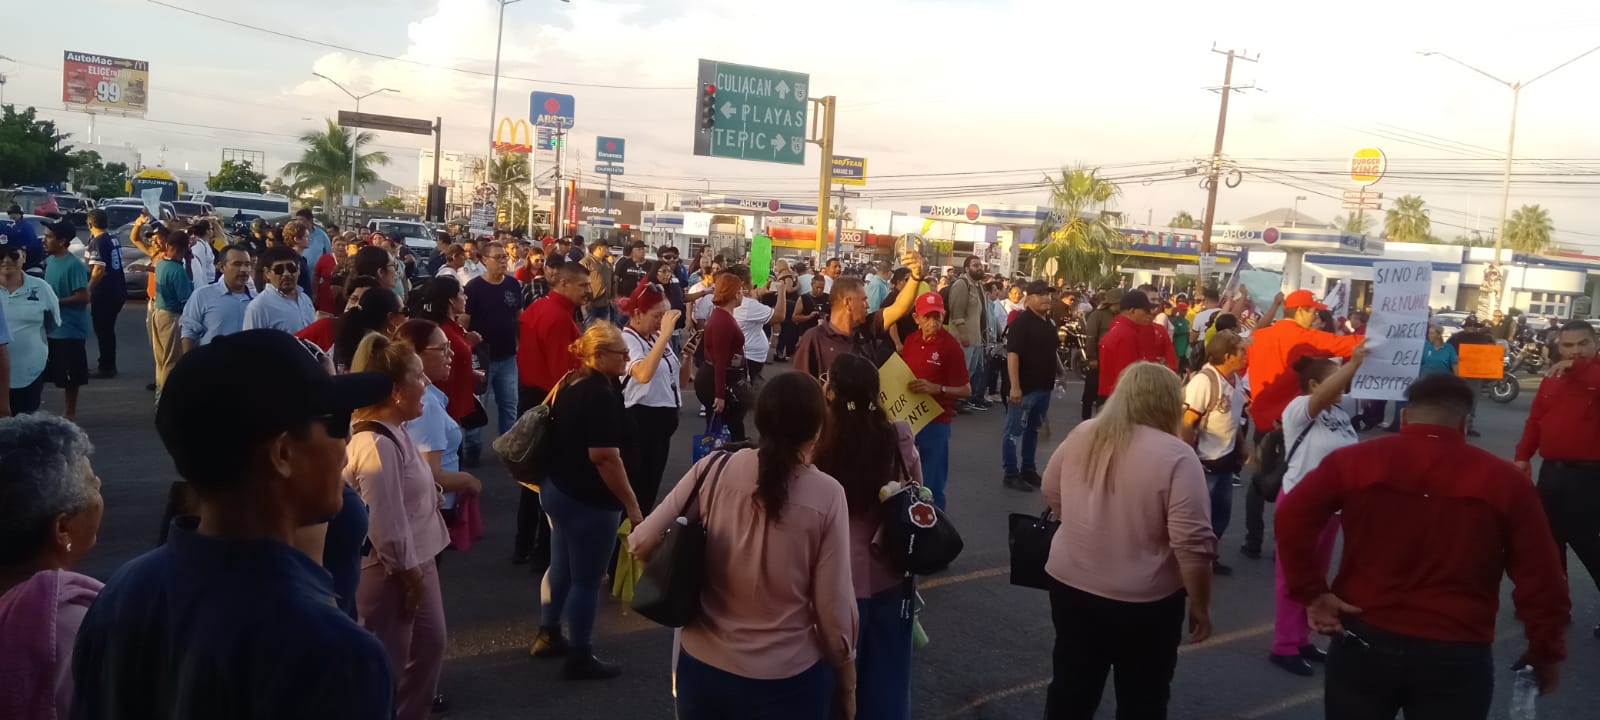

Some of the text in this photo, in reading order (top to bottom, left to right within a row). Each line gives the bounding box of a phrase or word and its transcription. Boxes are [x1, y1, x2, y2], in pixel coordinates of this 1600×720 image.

[67, 52, 113, 66] AutoMac
[88, 65, 111, 76] ELIGE
[717, 73, 772, 97] CULIACAN
[741, 103, 804, 128] PLAYAS
[715, 128, 767, 150] TEPIC
[832, 158, 863, 168] ODYEAR
[1351, 165, 1379, 176] KING
[581, 205, 622, 216] McDonld's
[740, 199, 763, 208] ARCO
[929, 204, 960, 217] ARCO
[1222, 229, 1256, 240] ARCO
[1376, 267, 1390, 284] SI
[1390, 266, 1412, 283] NO
[1391, 349, 1420, 366] DEL
[889, 393, 908, 418] TOR
[905, 400, 929, 425] NTE
